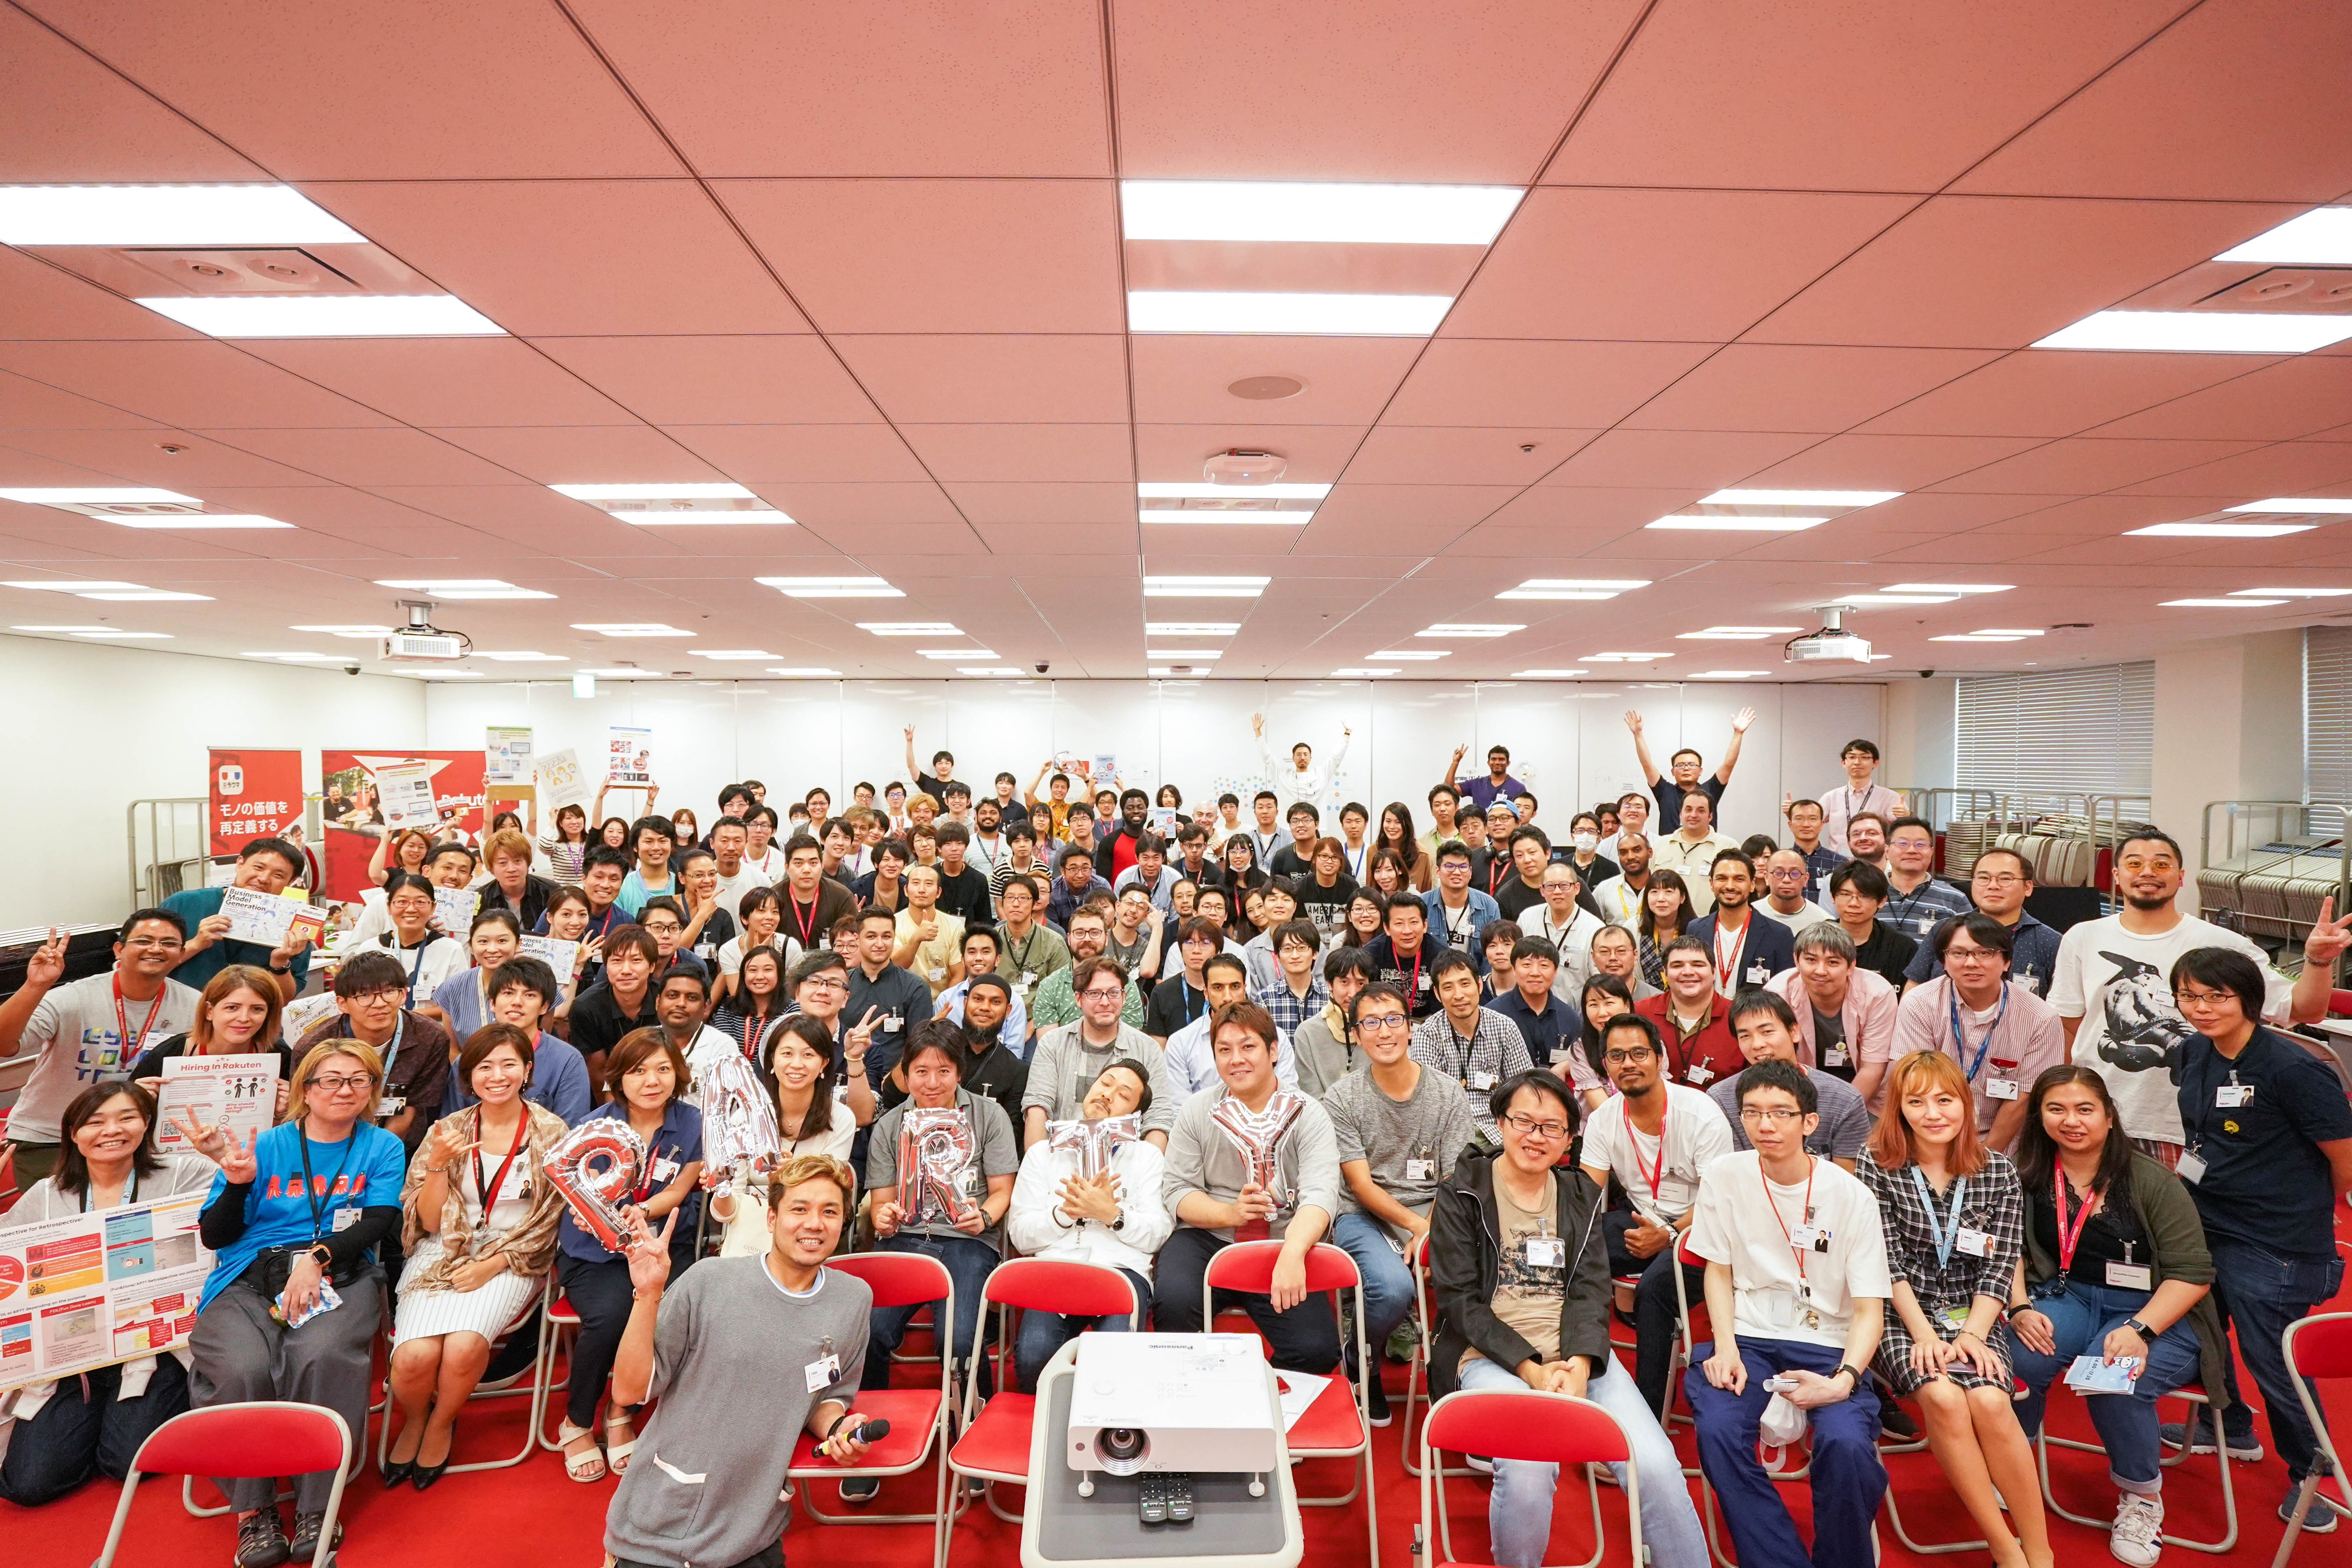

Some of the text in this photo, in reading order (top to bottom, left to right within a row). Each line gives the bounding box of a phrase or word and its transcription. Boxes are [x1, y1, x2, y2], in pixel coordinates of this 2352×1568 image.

[220, 801, 287, 817] モノの価値を
[220, 819, 278, 836] 再定義する
[227, 894, 252, 903] Model
[229, 889, 262, 899] Business
[226, 900, 266, 912] Generation
[181, 1064, 210, 1072] Hiring
[39, 1218, 83, 1229] Retrospective!
[148, 1273, 178, 1283] Retrospective
[26, 1303, 51, 1311] depending
